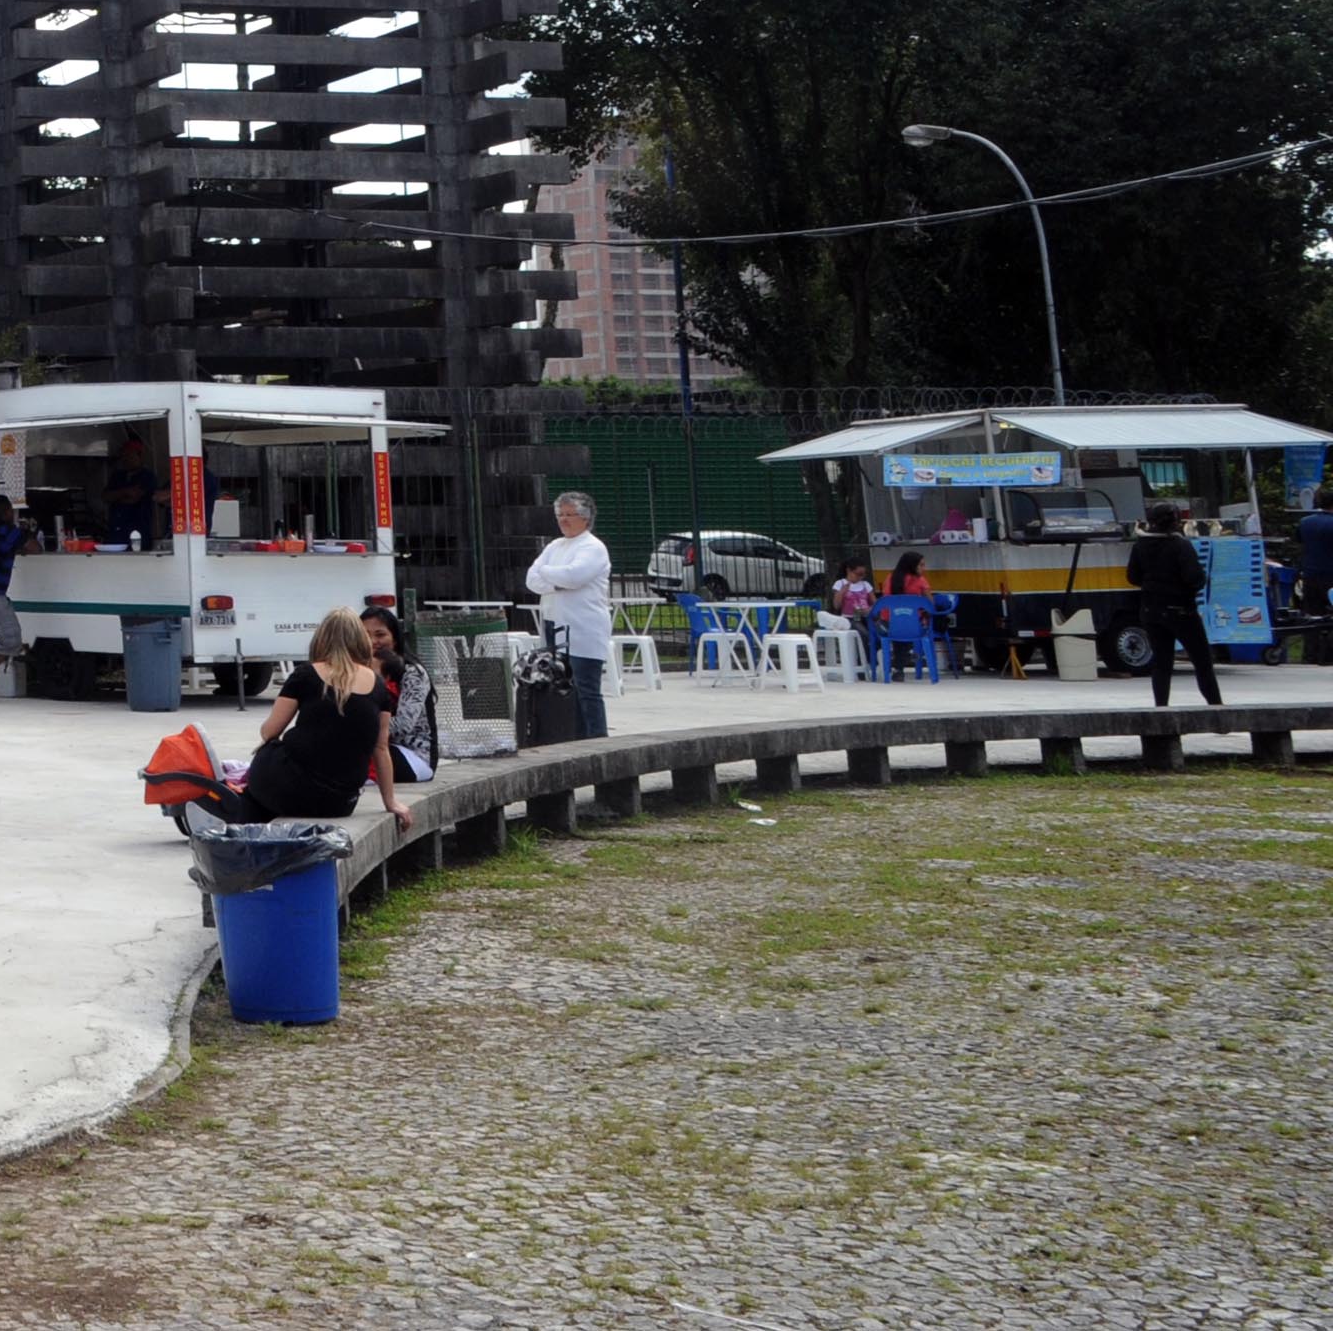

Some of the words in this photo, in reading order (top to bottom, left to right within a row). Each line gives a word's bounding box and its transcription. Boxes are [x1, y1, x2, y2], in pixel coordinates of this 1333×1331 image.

[174, 458, 184, 532] ESPETINHO
[192, 458, 202, 532] ESPETINHO
[378, 453, 388, 525] ESPETINHO
